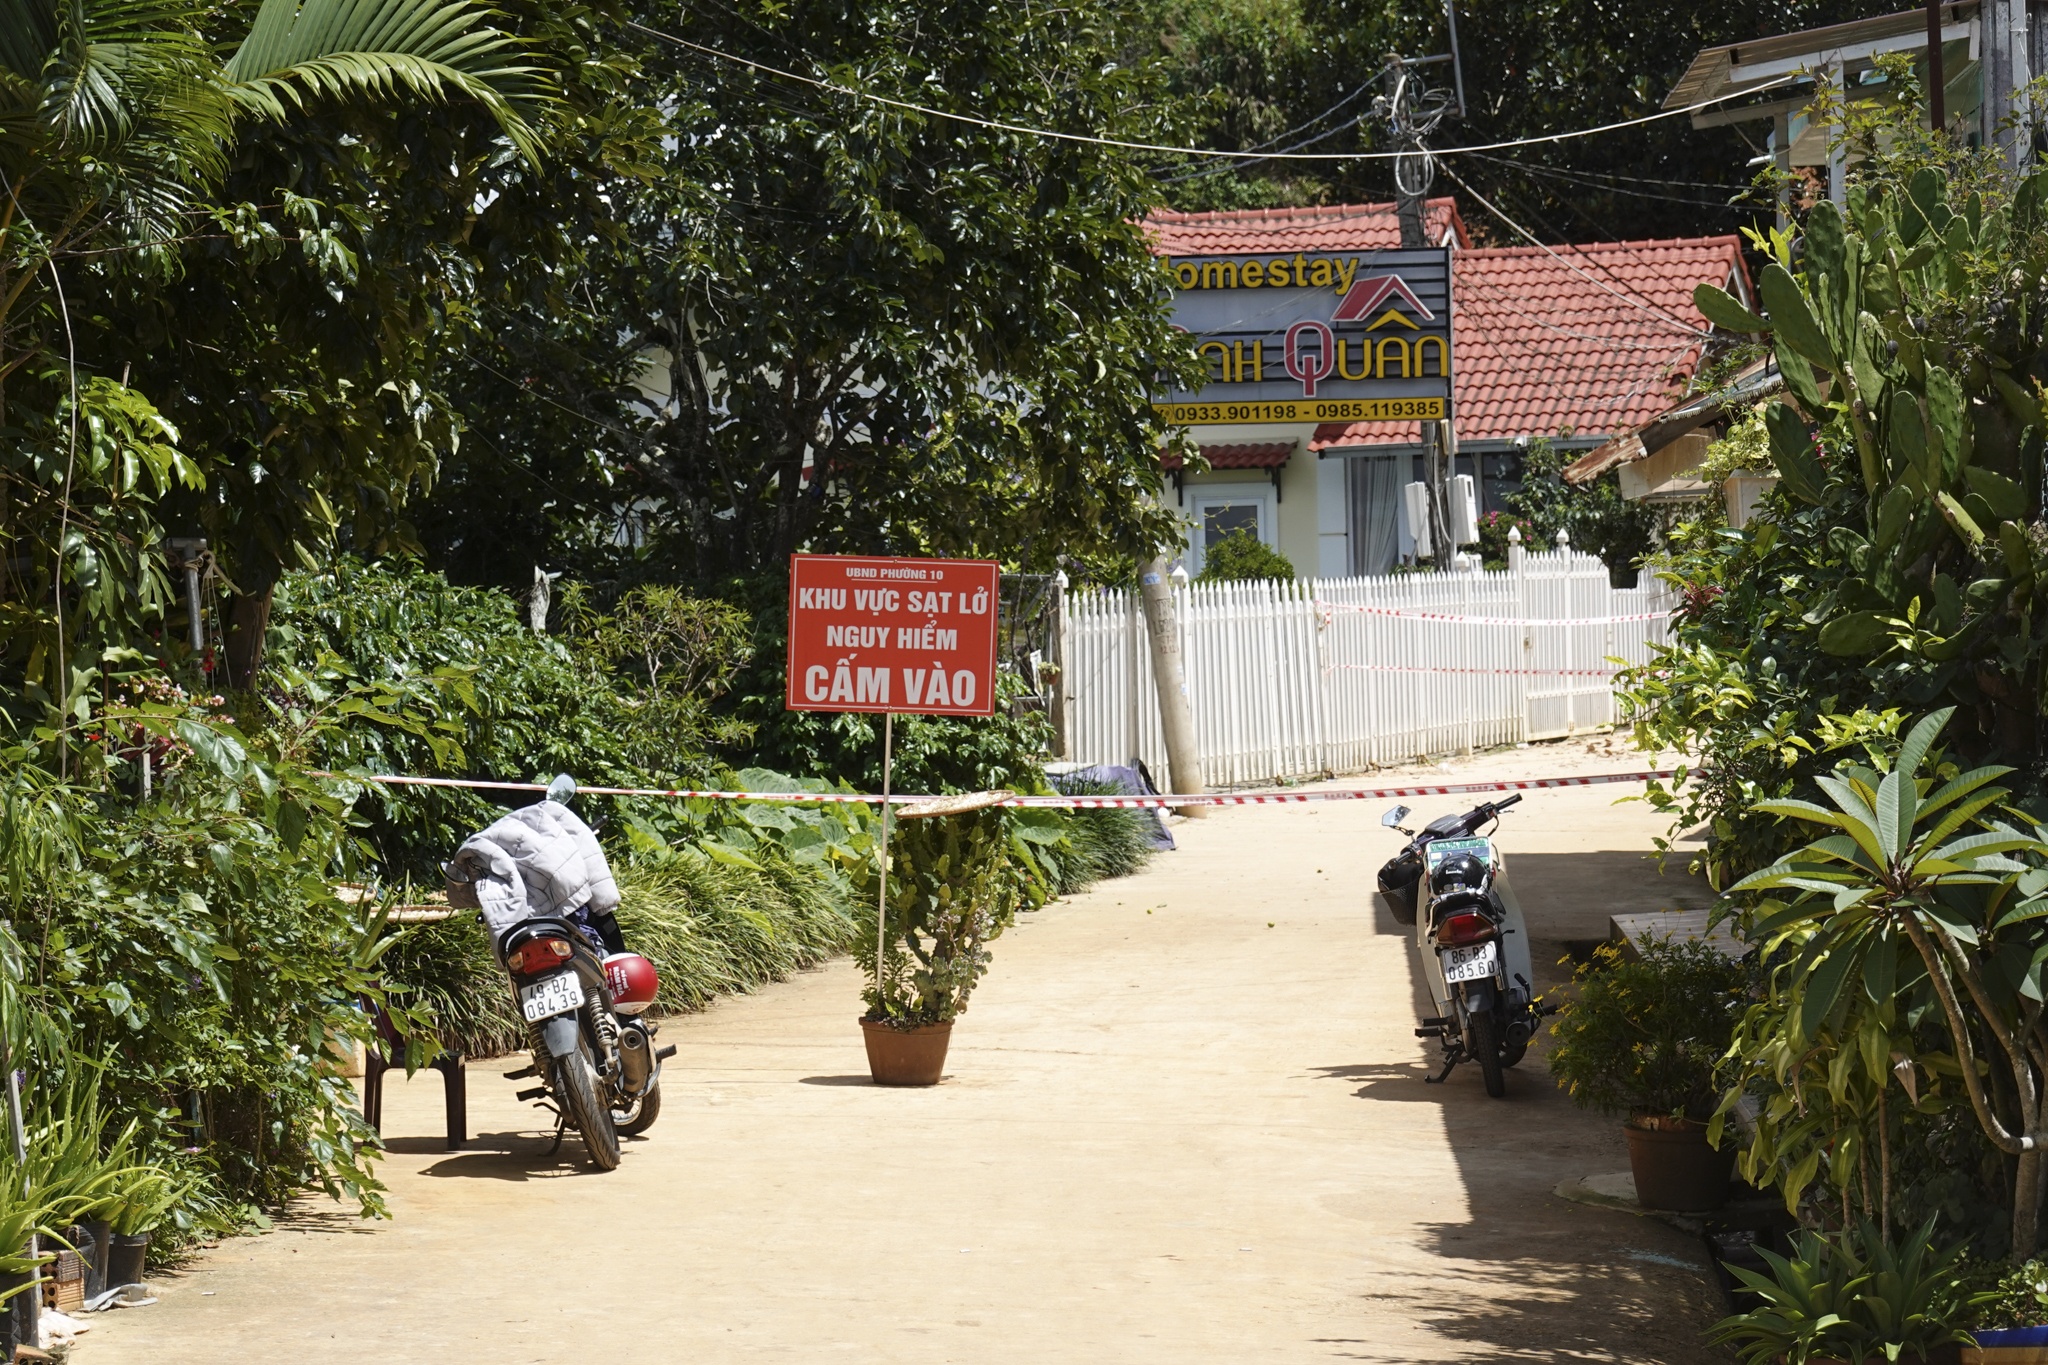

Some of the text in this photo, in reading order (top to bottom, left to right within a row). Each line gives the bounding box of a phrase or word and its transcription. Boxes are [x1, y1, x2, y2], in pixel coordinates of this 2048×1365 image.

[1175, 405, 1297, 421] 0933.901198
[1316, 402, 1440, 418] 0985.119385
[845, 567, 944, 580] UBND PHƯỜNG 10
[800, 586, 988, 618] KHU VỰC SẠT LỞ
[827, 620, 958, 650] NGUY HIỂM
[805, 653, 976, 706] CẤM VÀO
[1448, 960, 1495, 980] 085.60
[527, 991, 578, 1019] 084.39
